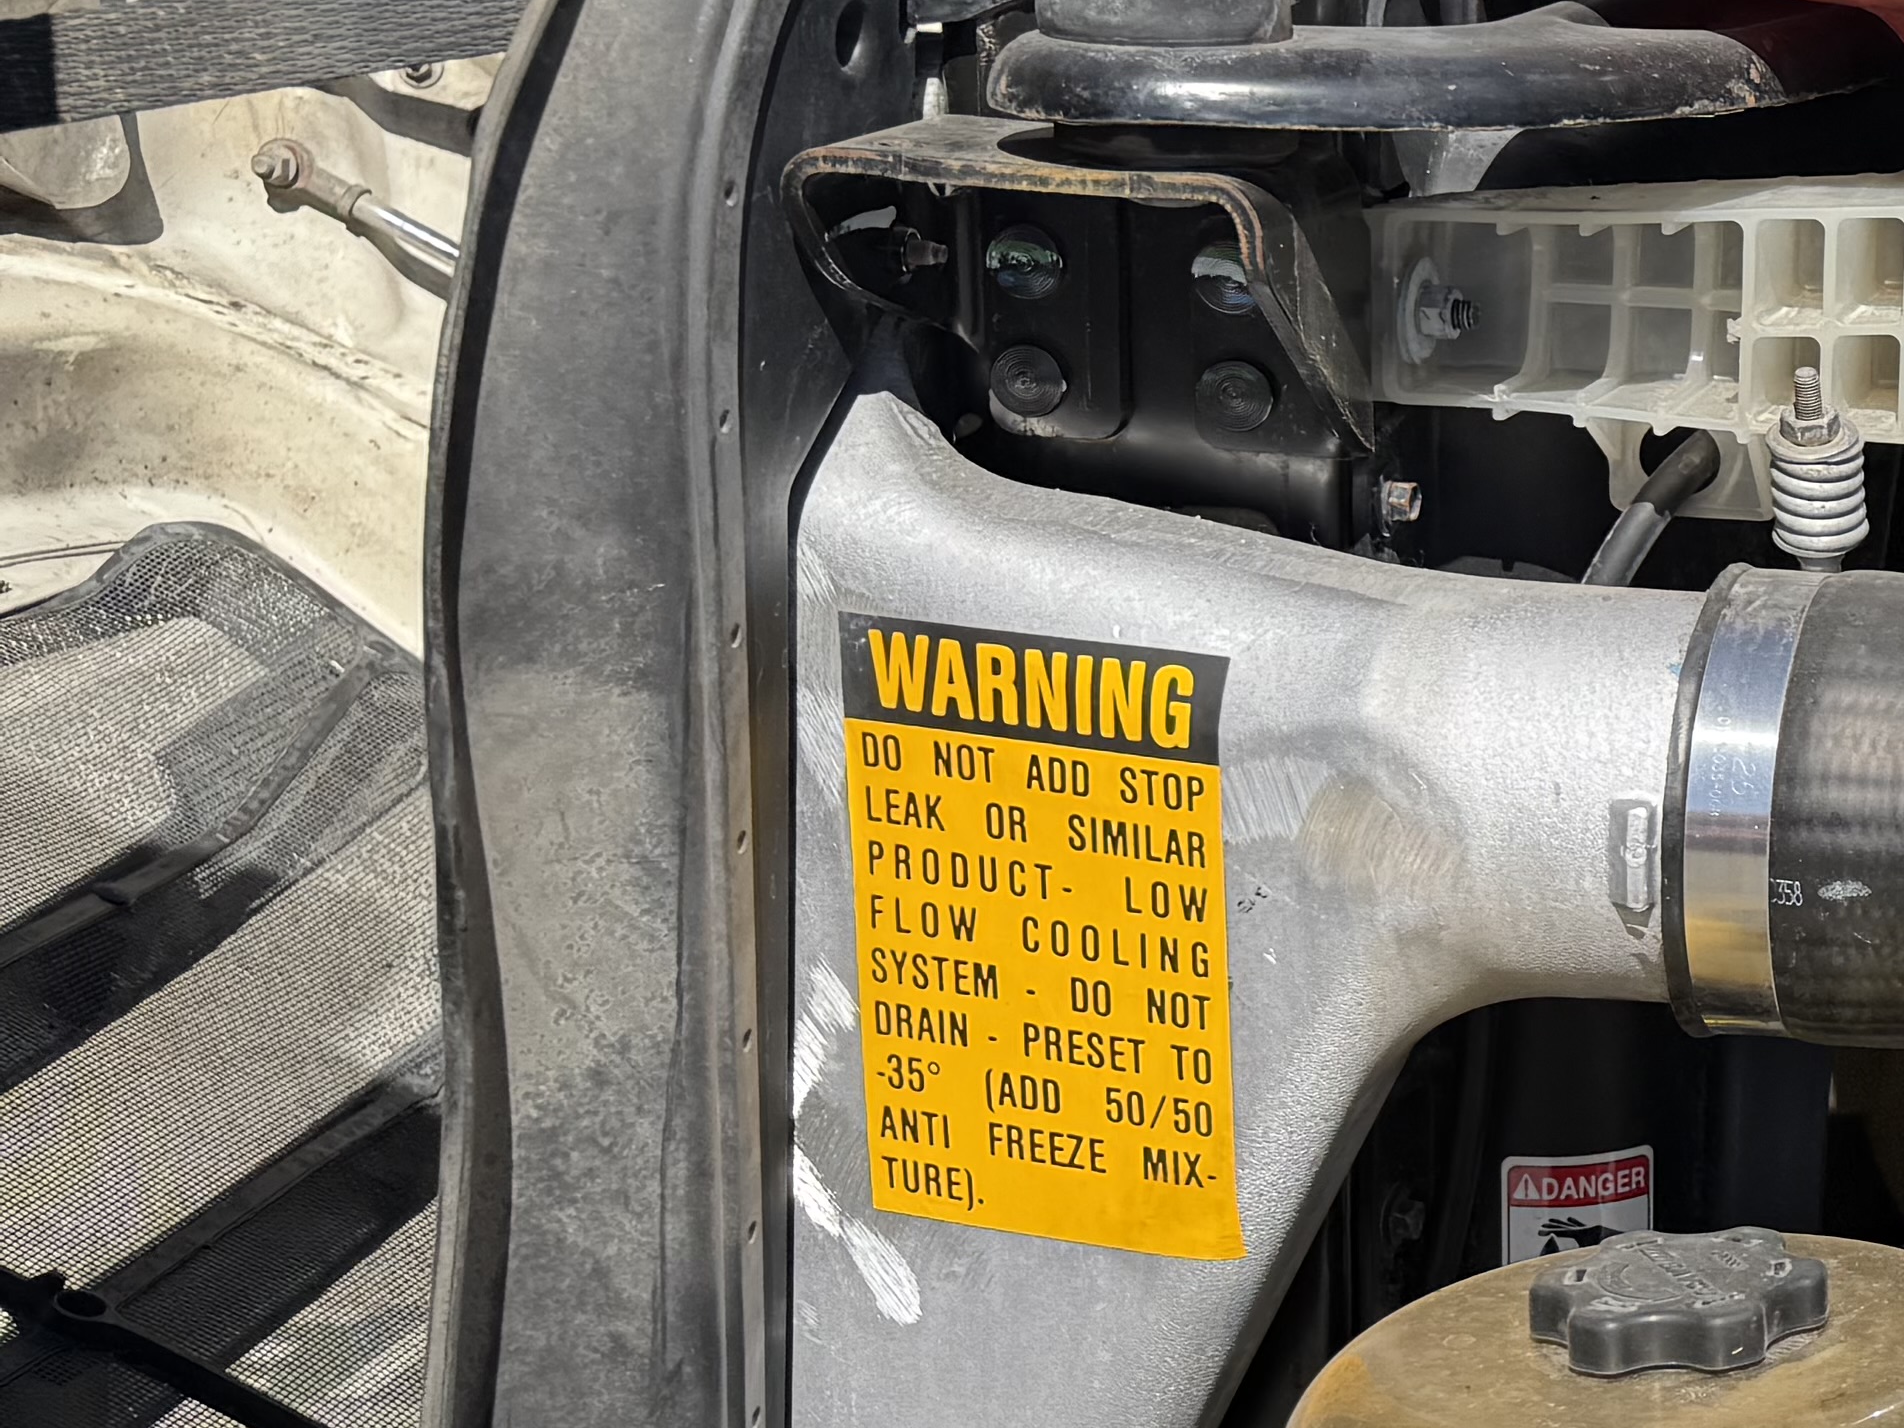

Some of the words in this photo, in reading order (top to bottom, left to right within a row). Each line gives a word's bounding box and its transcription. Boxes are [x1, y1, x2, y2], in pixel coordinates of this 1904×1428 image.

[867, 628, 1194, 749] WARNING
[862, 731, 901, 770] DO
[934, 740, 995, 785] NOT
[1027, 755, 1090, 798] ADD
[1119, 767, 1205, 812] STOP
[865, 786, 945, 832] LEAK
[986, 804, 1027, 843] OR
[1068, 815, 1205, 869] SIMILAR
[868, 841, 1072, 900] PRODUCT-
[1126, 877, 1207, 923] LOW
[870, 895, 978, 943] FLOW
[1022, 917, 1209, 978] COOLING
[871, 951, 999, 1001] SYSTEM
[1070, 977, 1111, 1016] DO
[1146, 991, 1210, 1031] NOT
[874, 1002, 969, 1048] DRAIN
[1023, 1024, 1145, 1074] PRESET
[1171, 1043, 1213, 1085] TO
[876, 1057, 941, 1094] -35°
[986, 1069, 1062, 1115] (ADD
[1105, 1088, 1213, 1138] 50/50
[880, 1105, 951, 1149] ANTI
[988, 1123, 1107, 1175] FREEZE
[1143, 1147, 1217, 1188] MIX-
[881, 1156, 986, 1211] TURE).
[1541, 1167, 1645, 1199] DANGER
